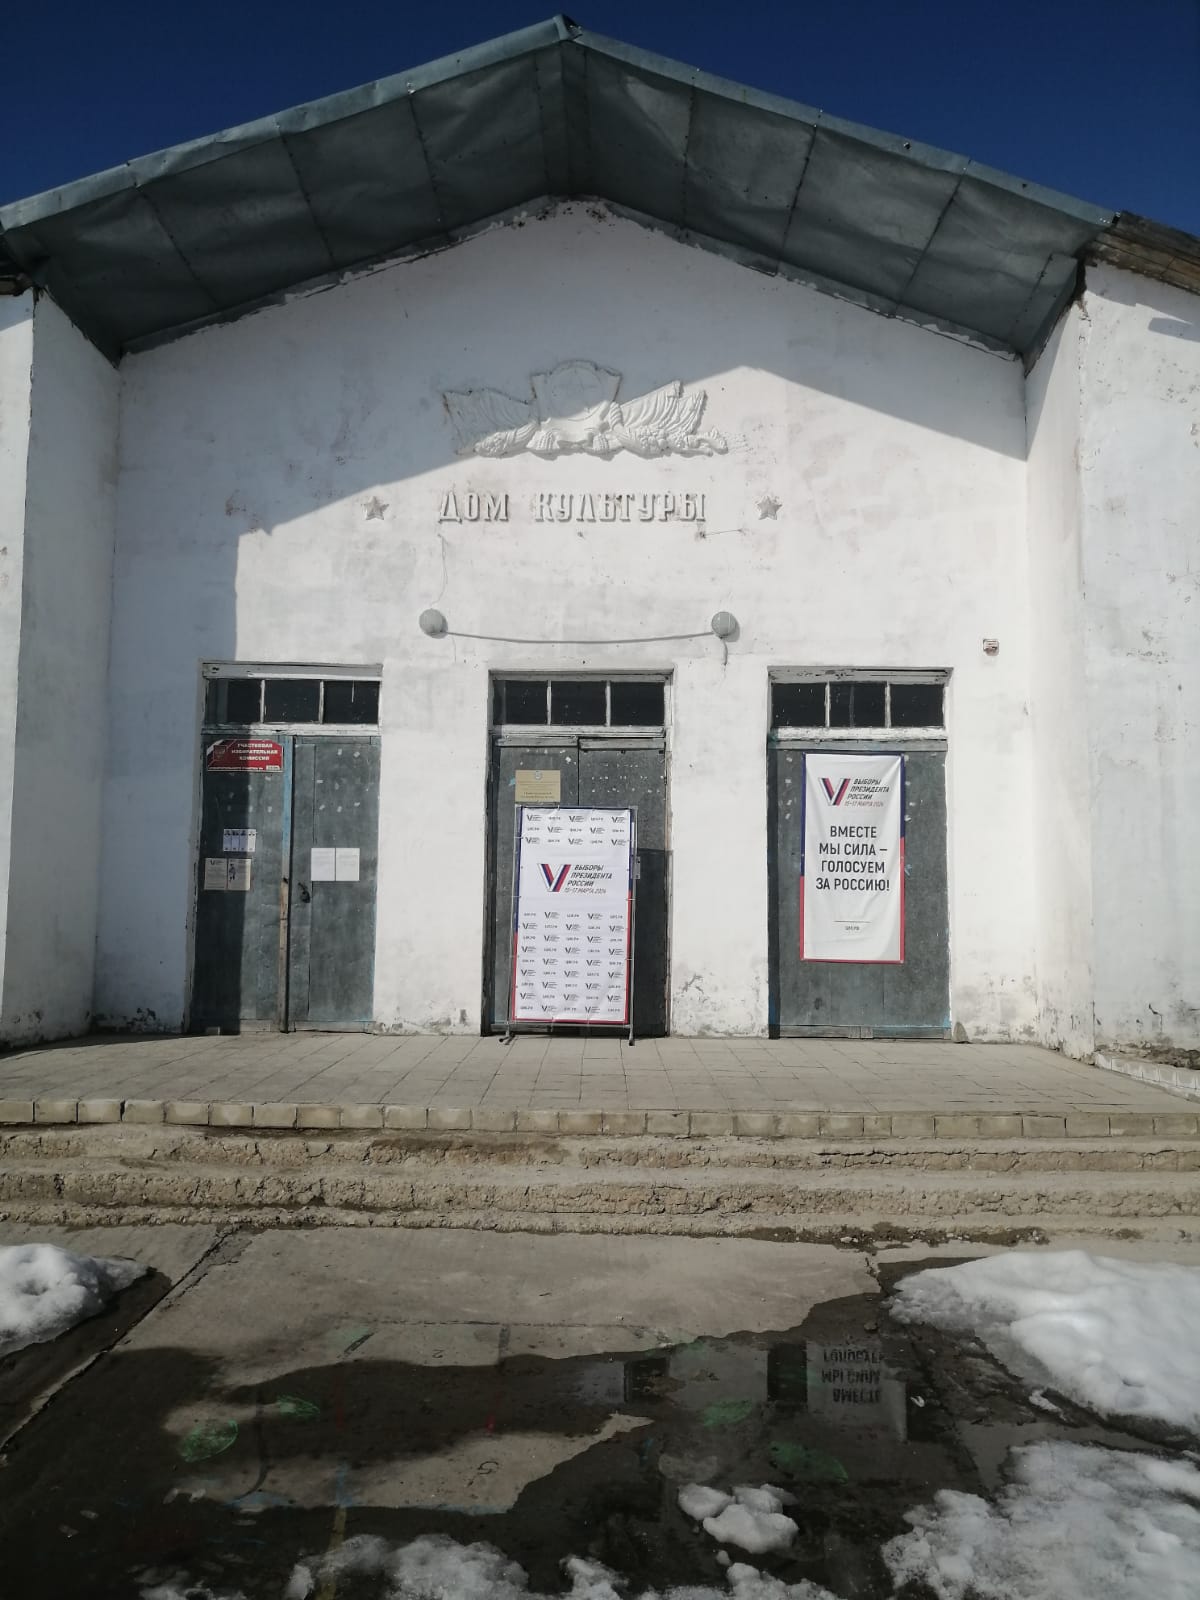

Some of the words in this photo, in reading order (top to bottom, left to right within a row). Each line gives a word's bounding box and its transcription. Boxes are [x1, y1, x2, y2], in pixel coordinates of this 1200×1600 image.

[438, 492, 510, 523] ДОМ
[534, 491, 707, 522] КУЛЬТУРЫ
[830, 826, 877, 838] ВМЕСТЕ
[819, 843, 840, 855] МЫ
[844, 843, 876, 855] СИЛА
[821, 860, 885, 873] ГОЛОСУЕМ
[570, 872, 613, 880] ПРЕЗИДЕНТА
[815, 877, 831, 890] ЗА
[834, 878, 890, 891] РОССИЮ!
